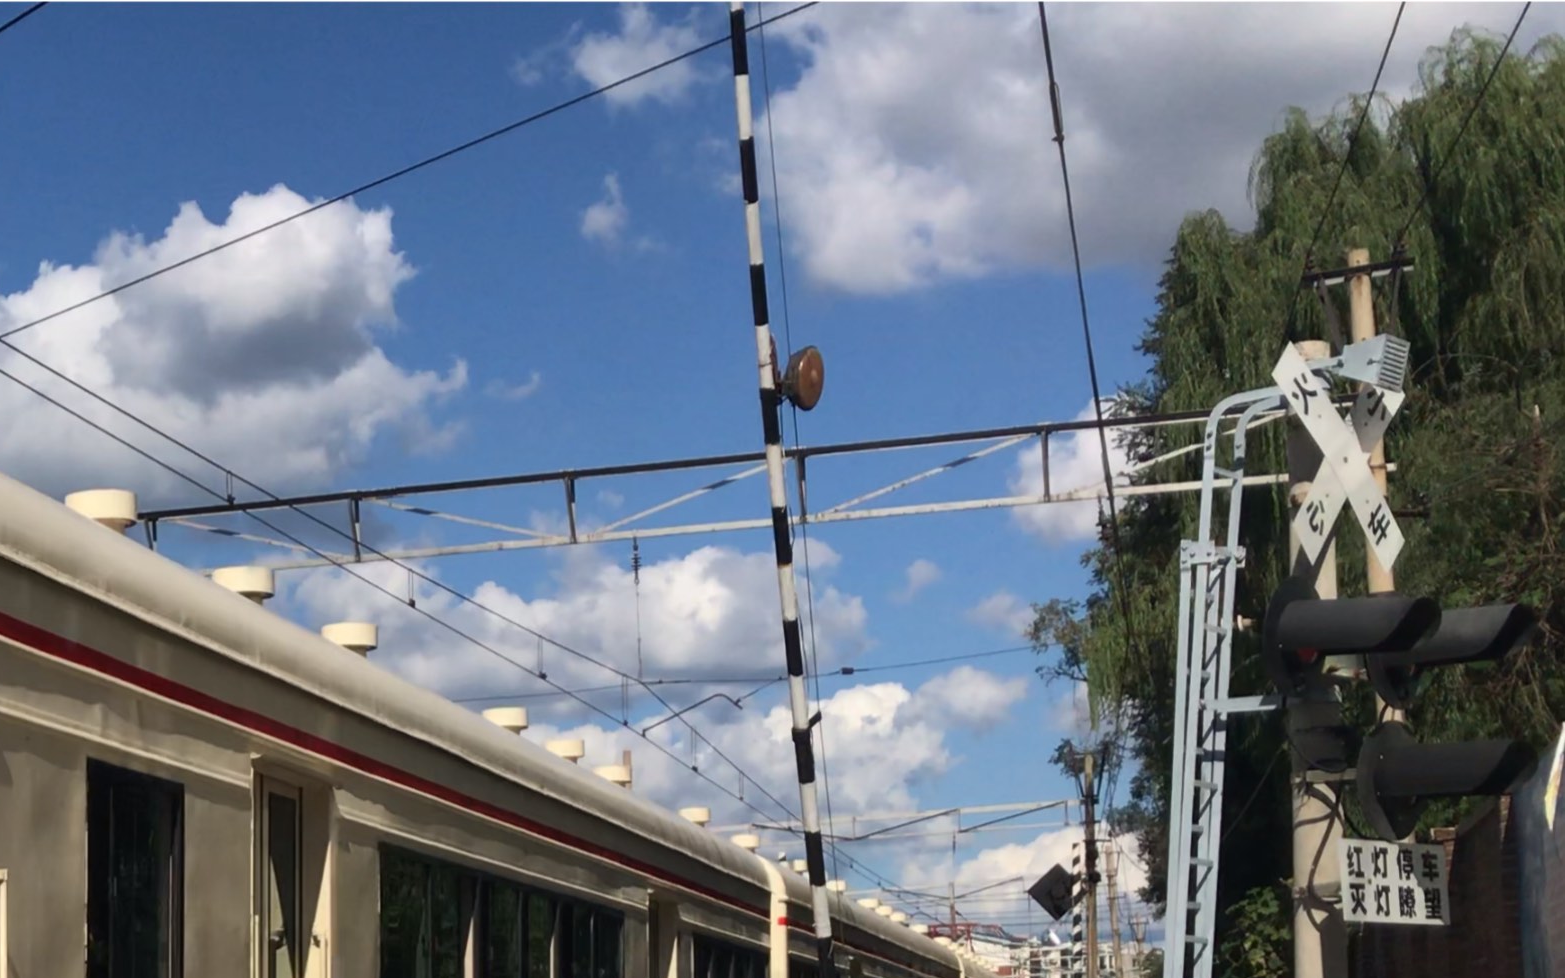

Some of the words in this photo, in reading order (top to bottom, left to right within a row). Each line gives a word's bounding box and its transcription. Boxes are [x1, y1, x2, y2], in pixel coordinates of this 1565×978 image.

[1366, 389, 1387, 421] 小
[1291, 372, 1317, 415] 火
[1367, 503, 1390, 546] 车
[1306, 500, 1325, 536] 心
[1347, 845, 1440, 883] 红灯停车
[1349, 882, 1443, 919] 灭灯瞭望
